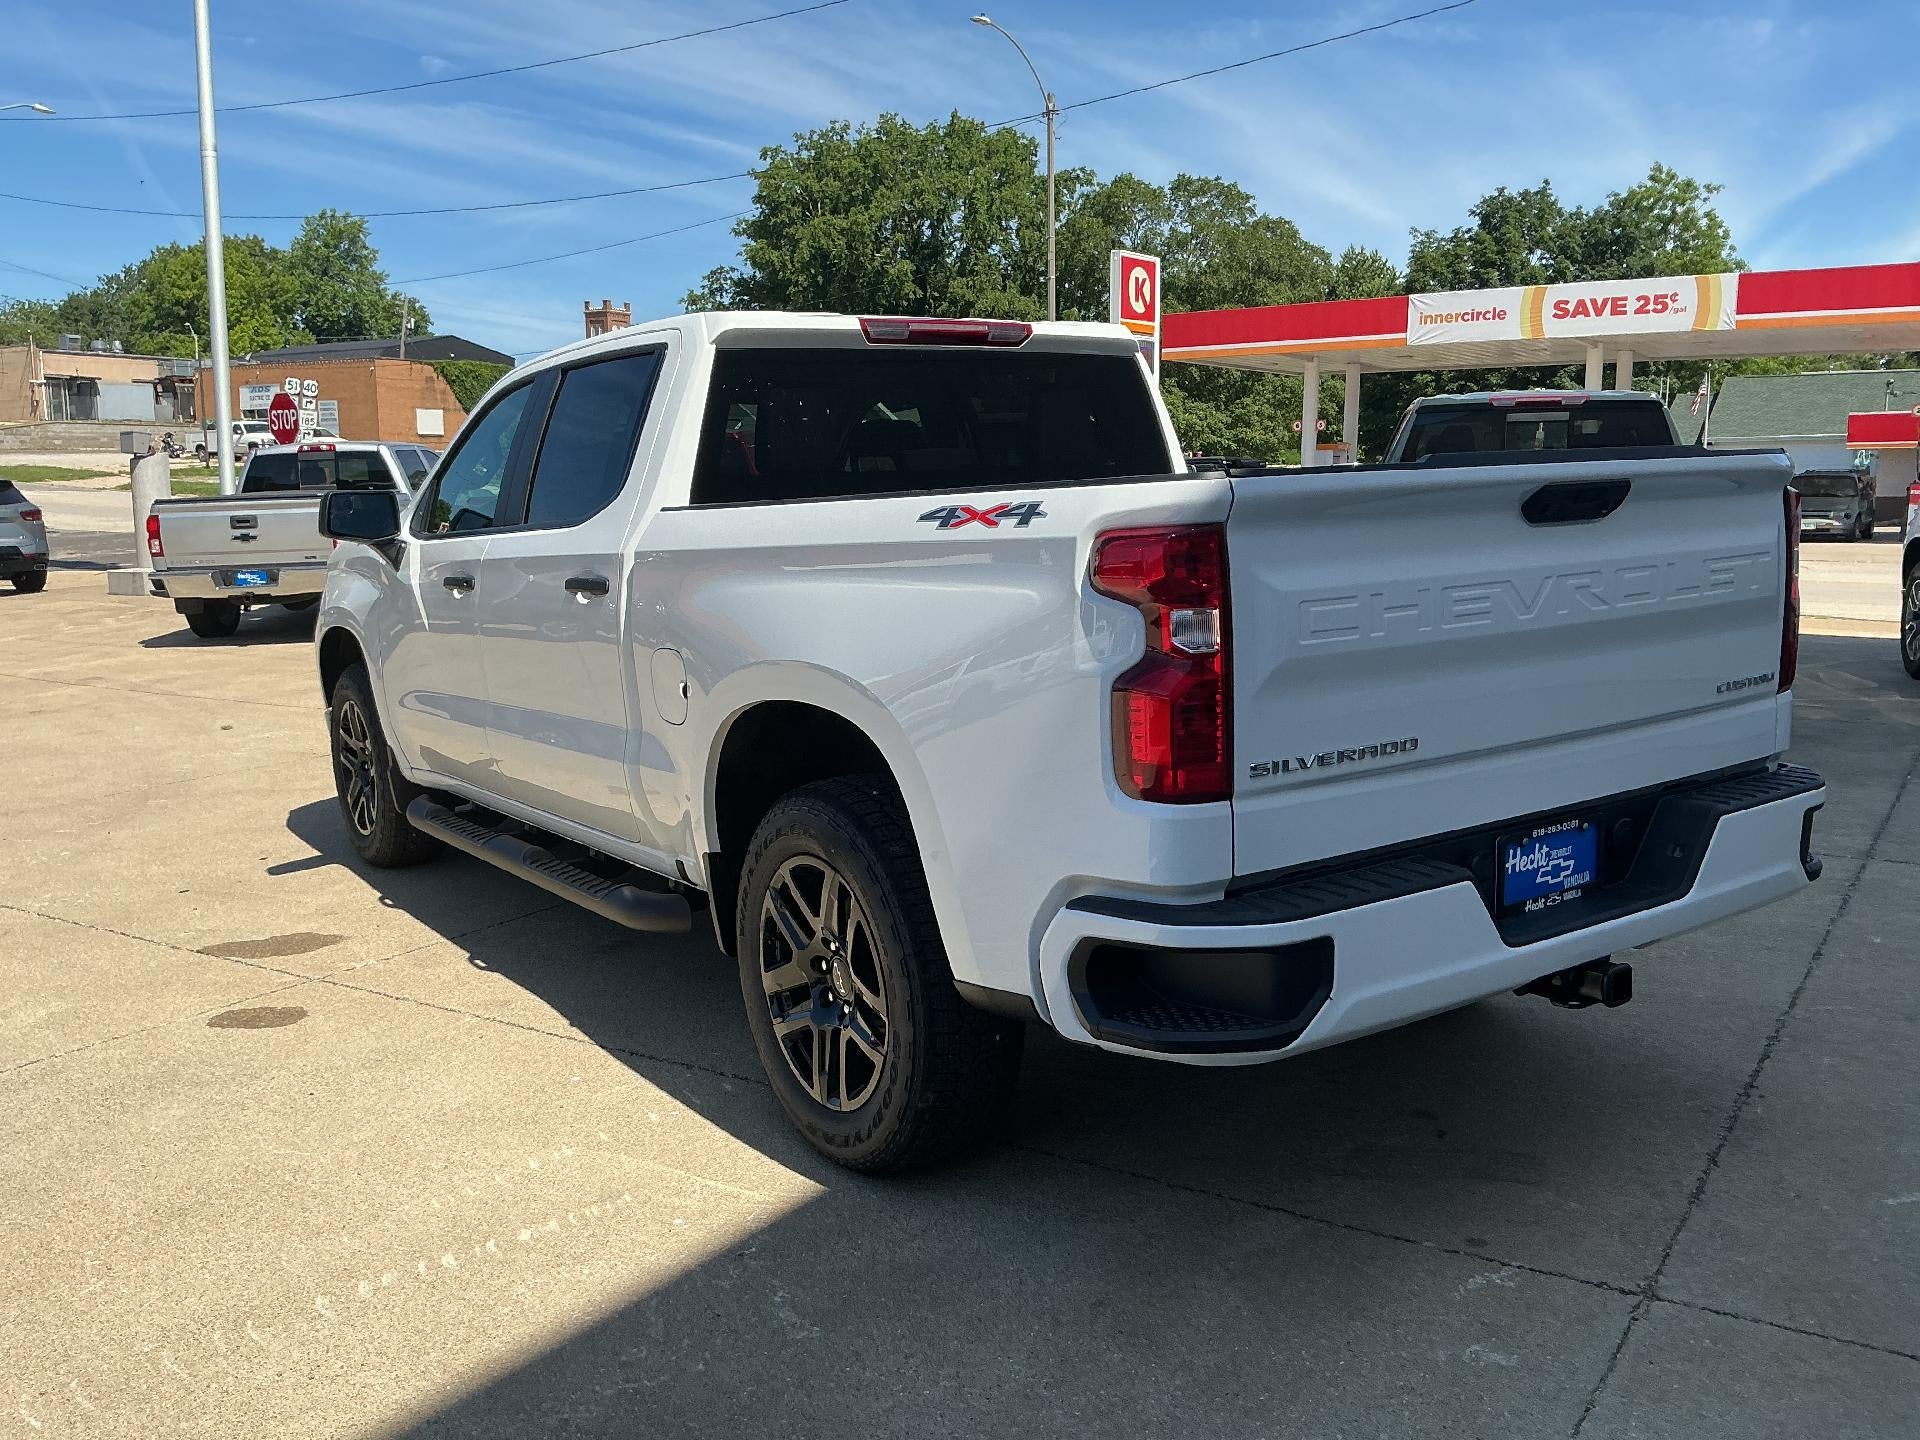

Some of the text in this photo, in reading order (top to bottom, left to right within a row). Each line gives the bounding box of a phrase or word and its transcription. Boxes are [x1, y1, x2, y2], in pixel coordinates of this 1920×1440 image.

[1135, 277, 1149, 311] K
[1419, 306, 1507, 325] innercircle
[1552, 296, 1628, 319] SAVE
[287, 380, 298, 391] 51
[303, 382, 317, 393] 40
[270, 409, 297, 431] STOP
[301, 417, 316, 426] 185
[1299, 552, 1771, 645] CHEVROLET
[1716, 671, 1775, 693] CUSTOM
[1249, 737, 1418, 778] SILVERADO
[1505, 843, 1549, 874] Hecht
[1563, 871, 1590, 889] VANDALIA
[1525, 897, 1545, 912] Hecht
